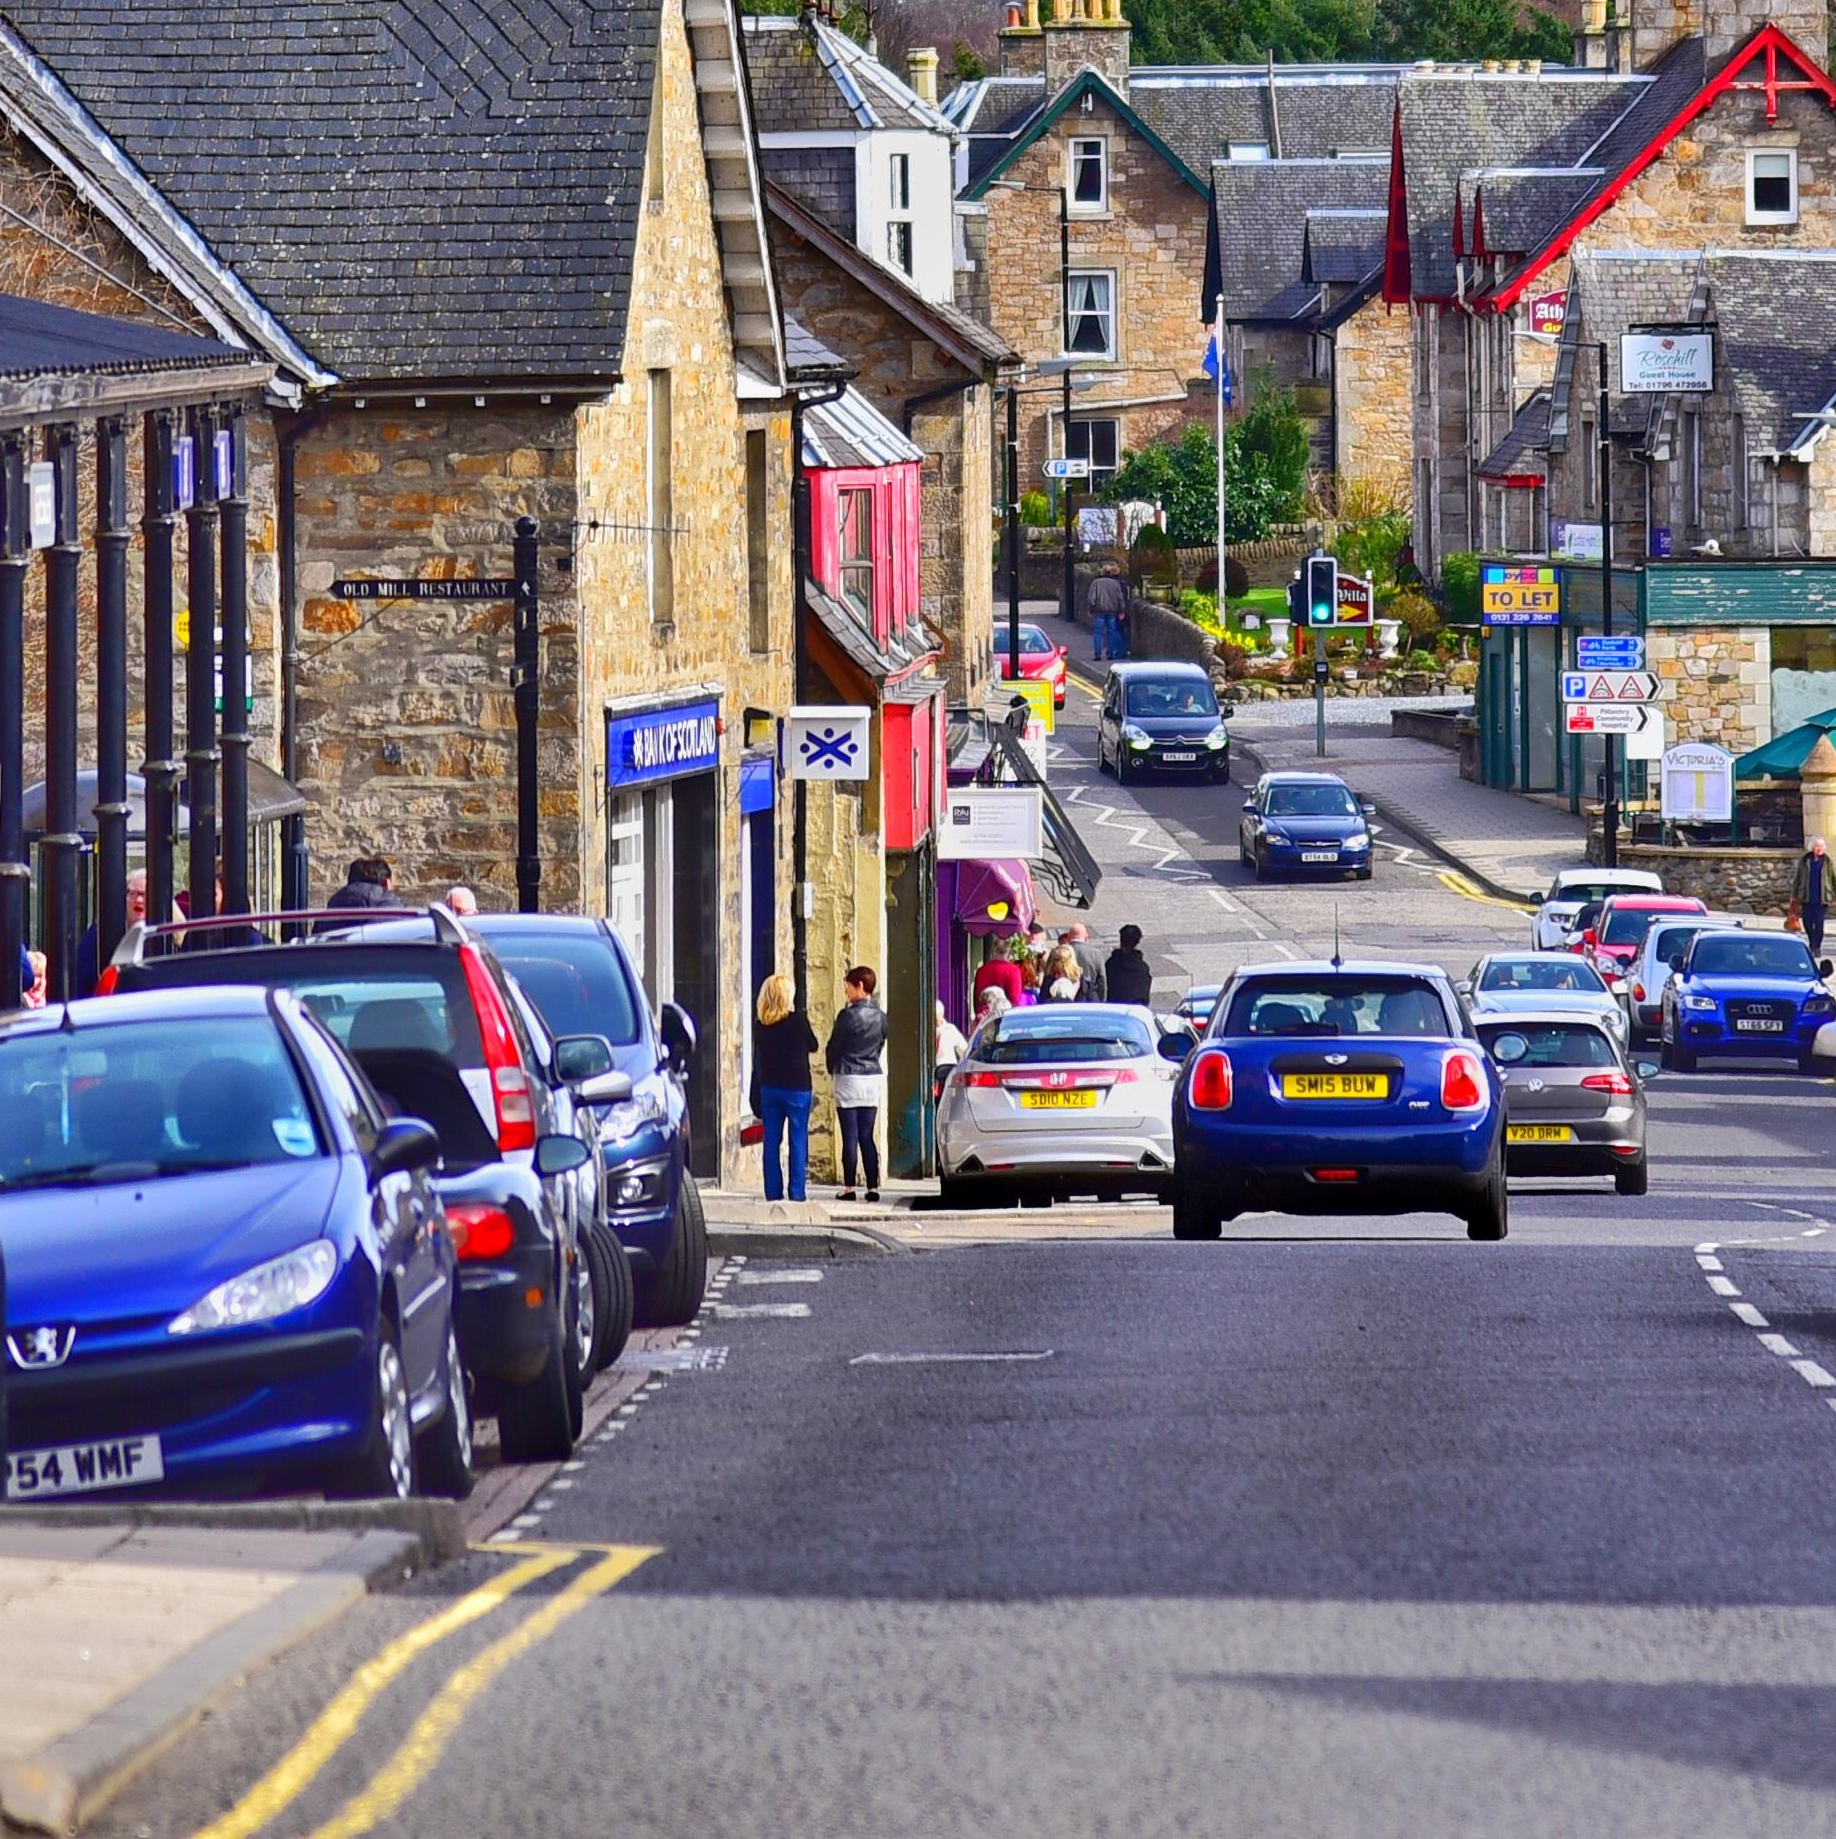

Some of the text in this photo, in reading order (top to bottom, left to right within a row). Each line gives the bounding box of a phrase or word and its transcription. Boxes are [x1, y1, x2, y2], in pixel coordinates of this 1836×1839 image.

[1535, 302, 1564, 320] Ath
[1636, 347, 1698, 368] Rosehill
[1639, 371, 1696, 379] Guest House
[1629, 381, 1643, 389] Tel:
[343, 581, 509, 596] OLD MILL RESTAURANT
[1337, 588, 1367, 602] Villa
[1489, 591, 1554, 606] TO LET
[1569, 678, 1584, 696] P
[644, 715, 716, 768] BANK OF SCOTLAND
[1666, 753, 1726, 766] VICTORIA'S
[1295, 1077, 1377, 1093] SM15 BUW
[1030, 1092, 1088, 1107] SD10 NZE
[1510, 1126, 1562, 1139] V20 DRM
[73, 1440, 145, 1484] WMF
